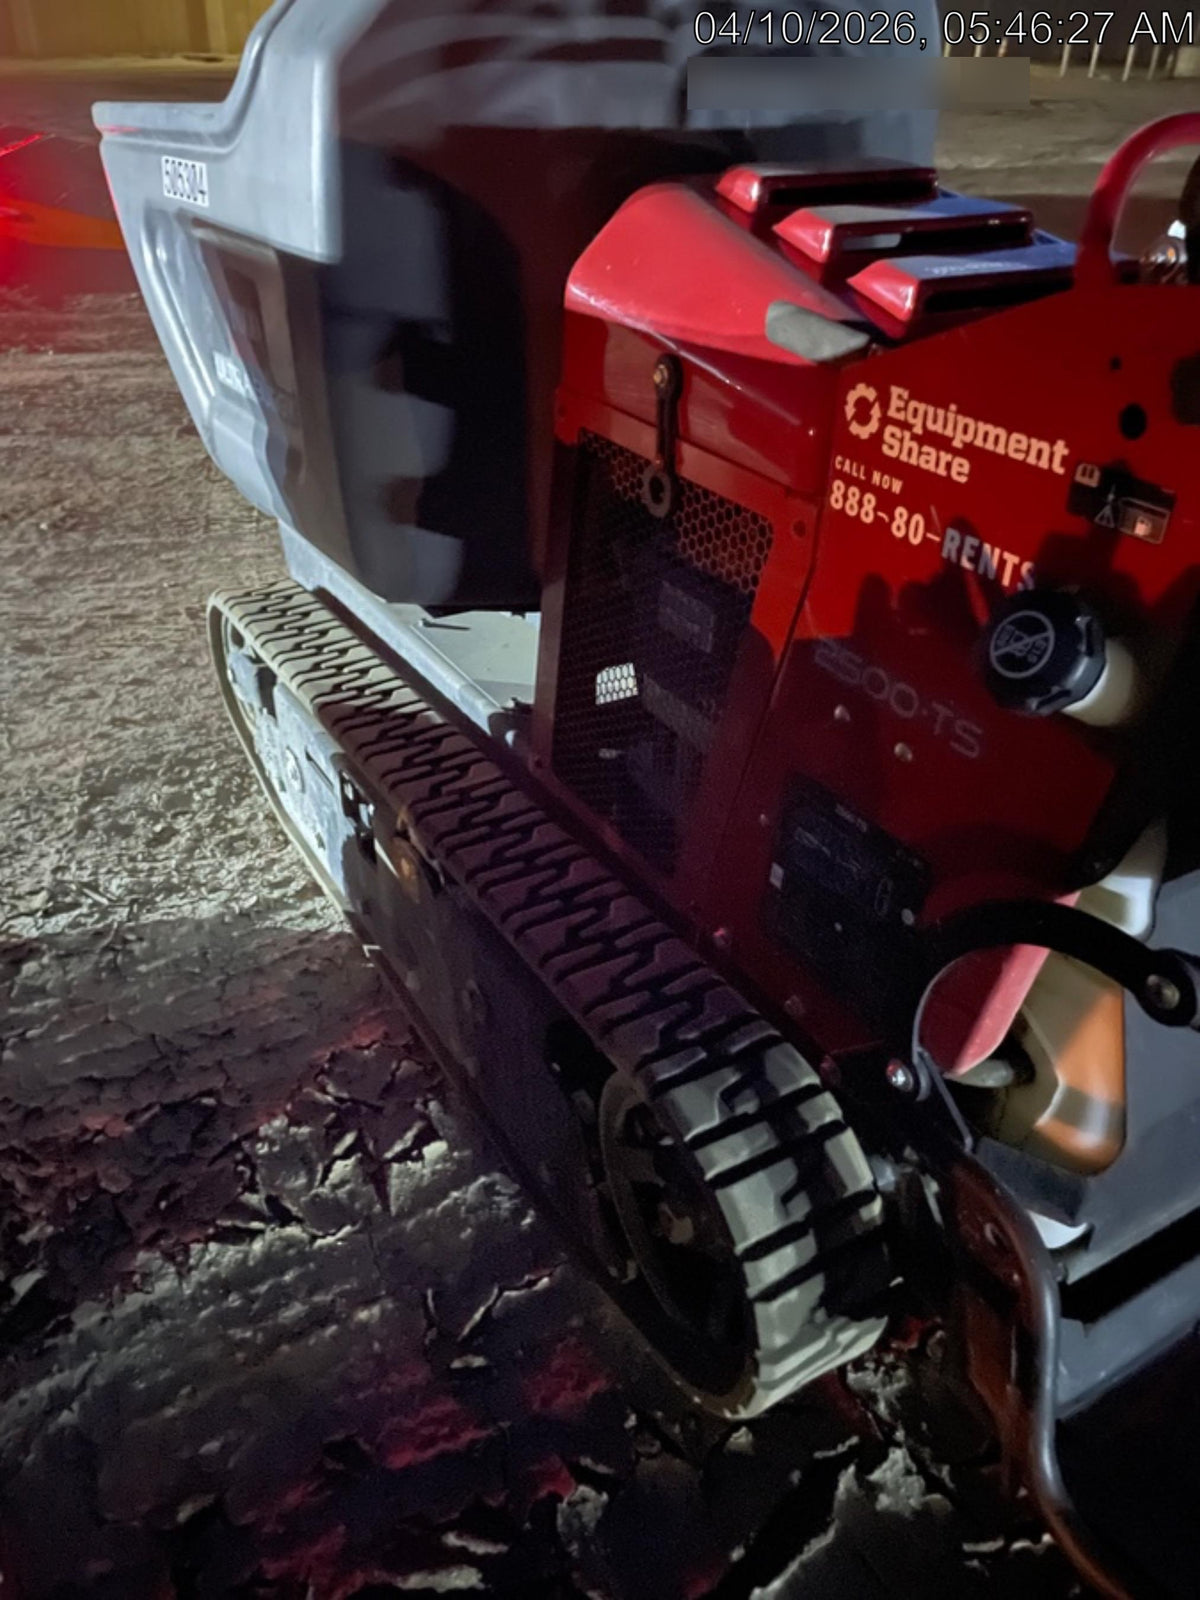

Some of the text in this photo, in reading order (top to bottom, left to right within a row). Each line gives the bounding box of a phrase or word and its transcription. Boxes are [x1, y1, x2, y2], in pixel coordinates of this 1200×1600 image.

[881, 424, 971, 484] Share
[886, 385, 1070, 475] Equipment
[834, 454, 904, 495] CALL NOW
[829, 478, 1036, 593] 888-80-RENTS
